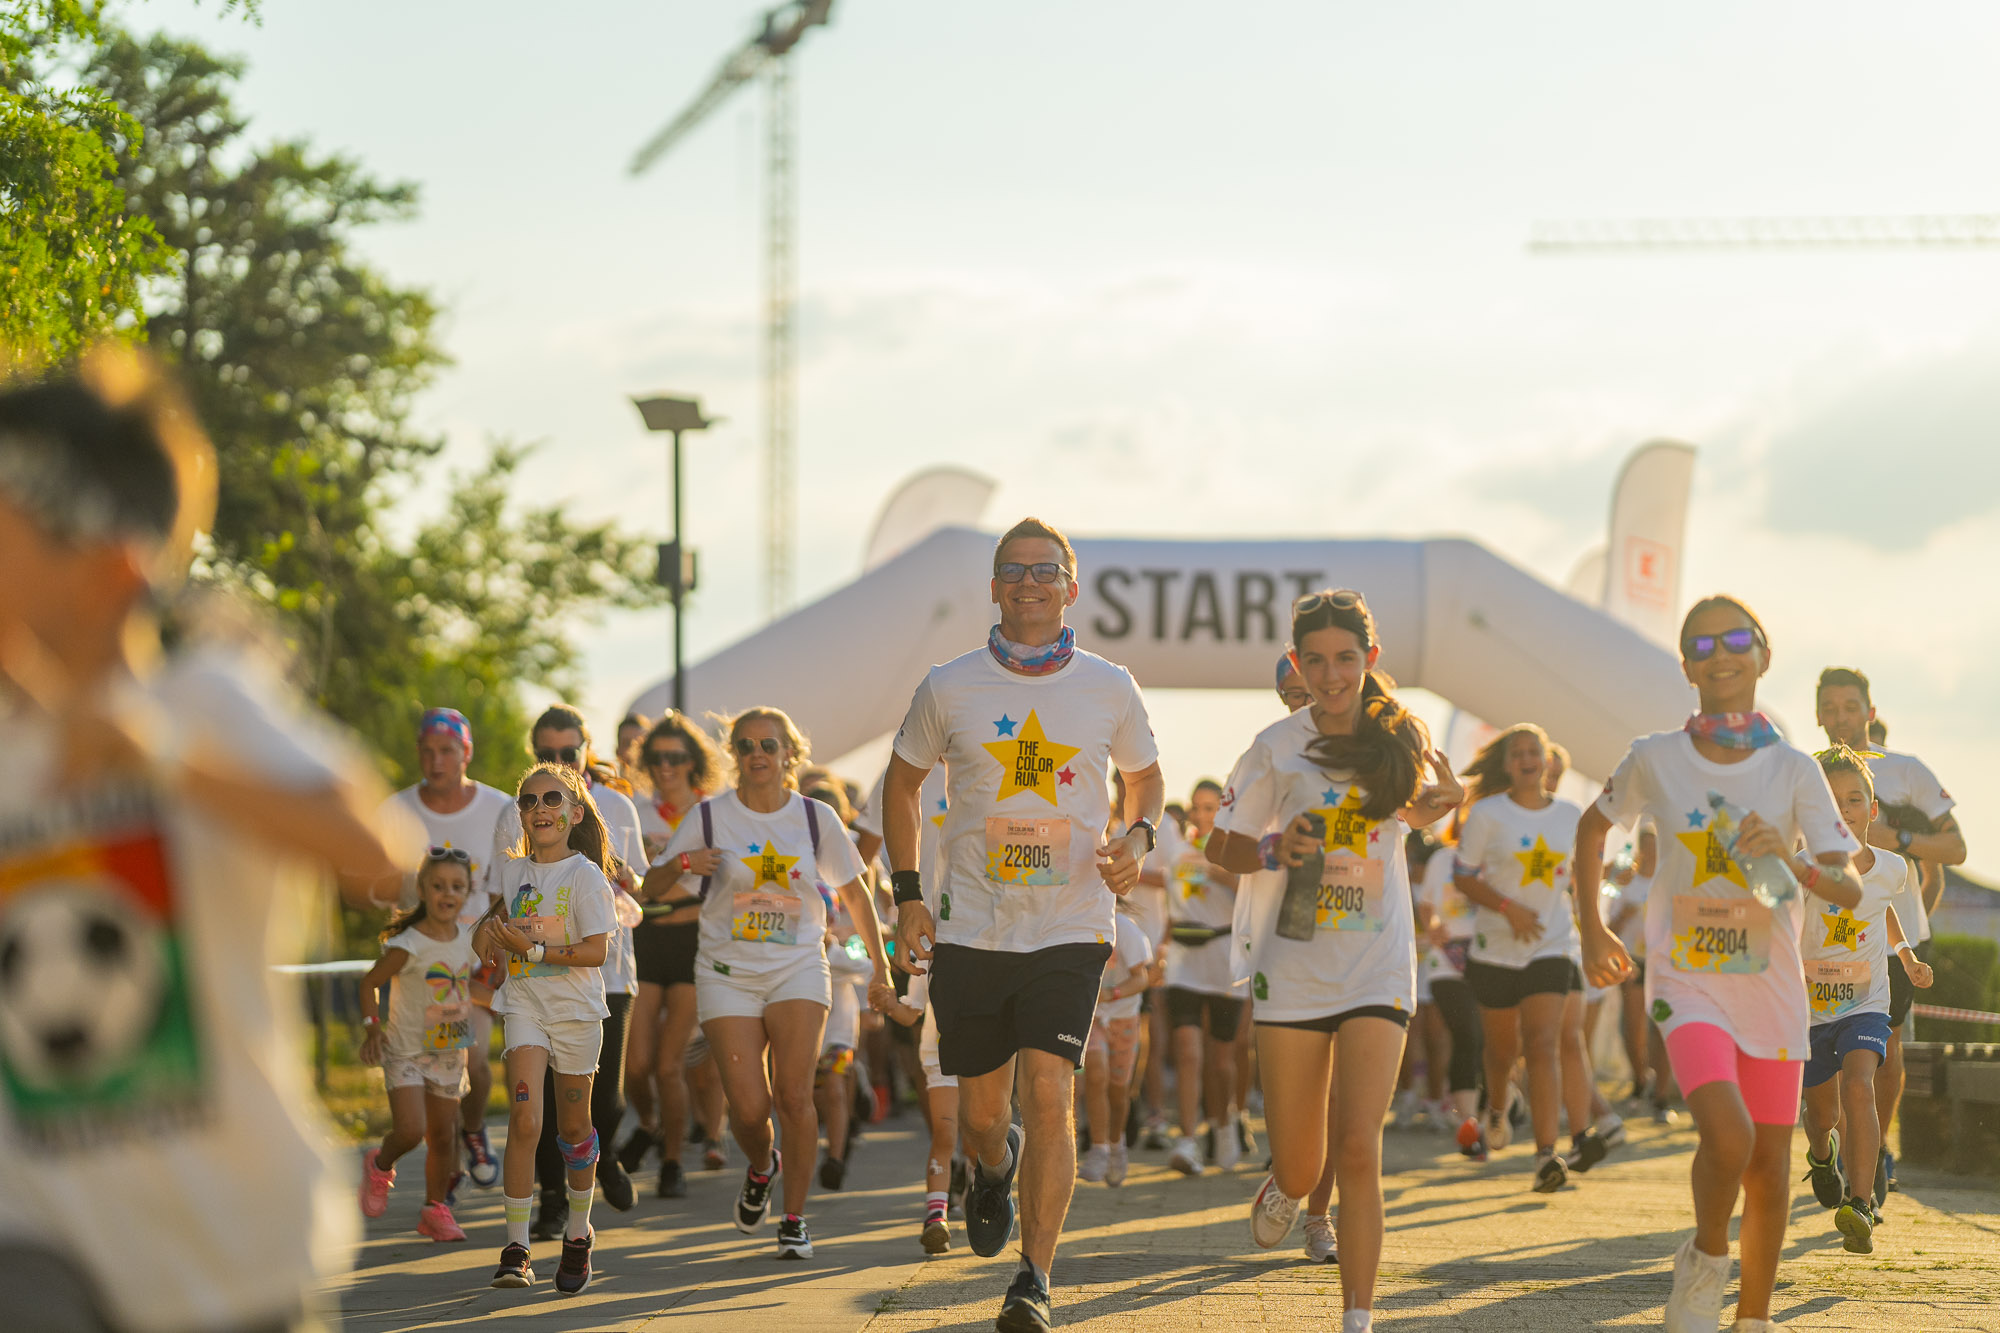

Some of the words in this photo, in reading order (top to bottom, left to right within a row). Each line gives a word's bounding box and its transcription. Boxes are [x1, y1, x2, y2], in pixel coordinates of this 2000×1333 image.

[1018, 740, 1039, 757] THE
[1016, 756, 1054, 774] COLOR
[1335, 820, 1366, 834] COLOR
[1004, 844, 1050, 869] 22805
[1317, 884, 1364, 912] 22803
[748, 911, 785, 931] 21272
[1837, 917, 1850, 927] THE
[1695, 926, 1747, 955] 22804
[1815, 982, 1854, 1001] 20435
[1057, 1033, 1082, 1047] adidas
